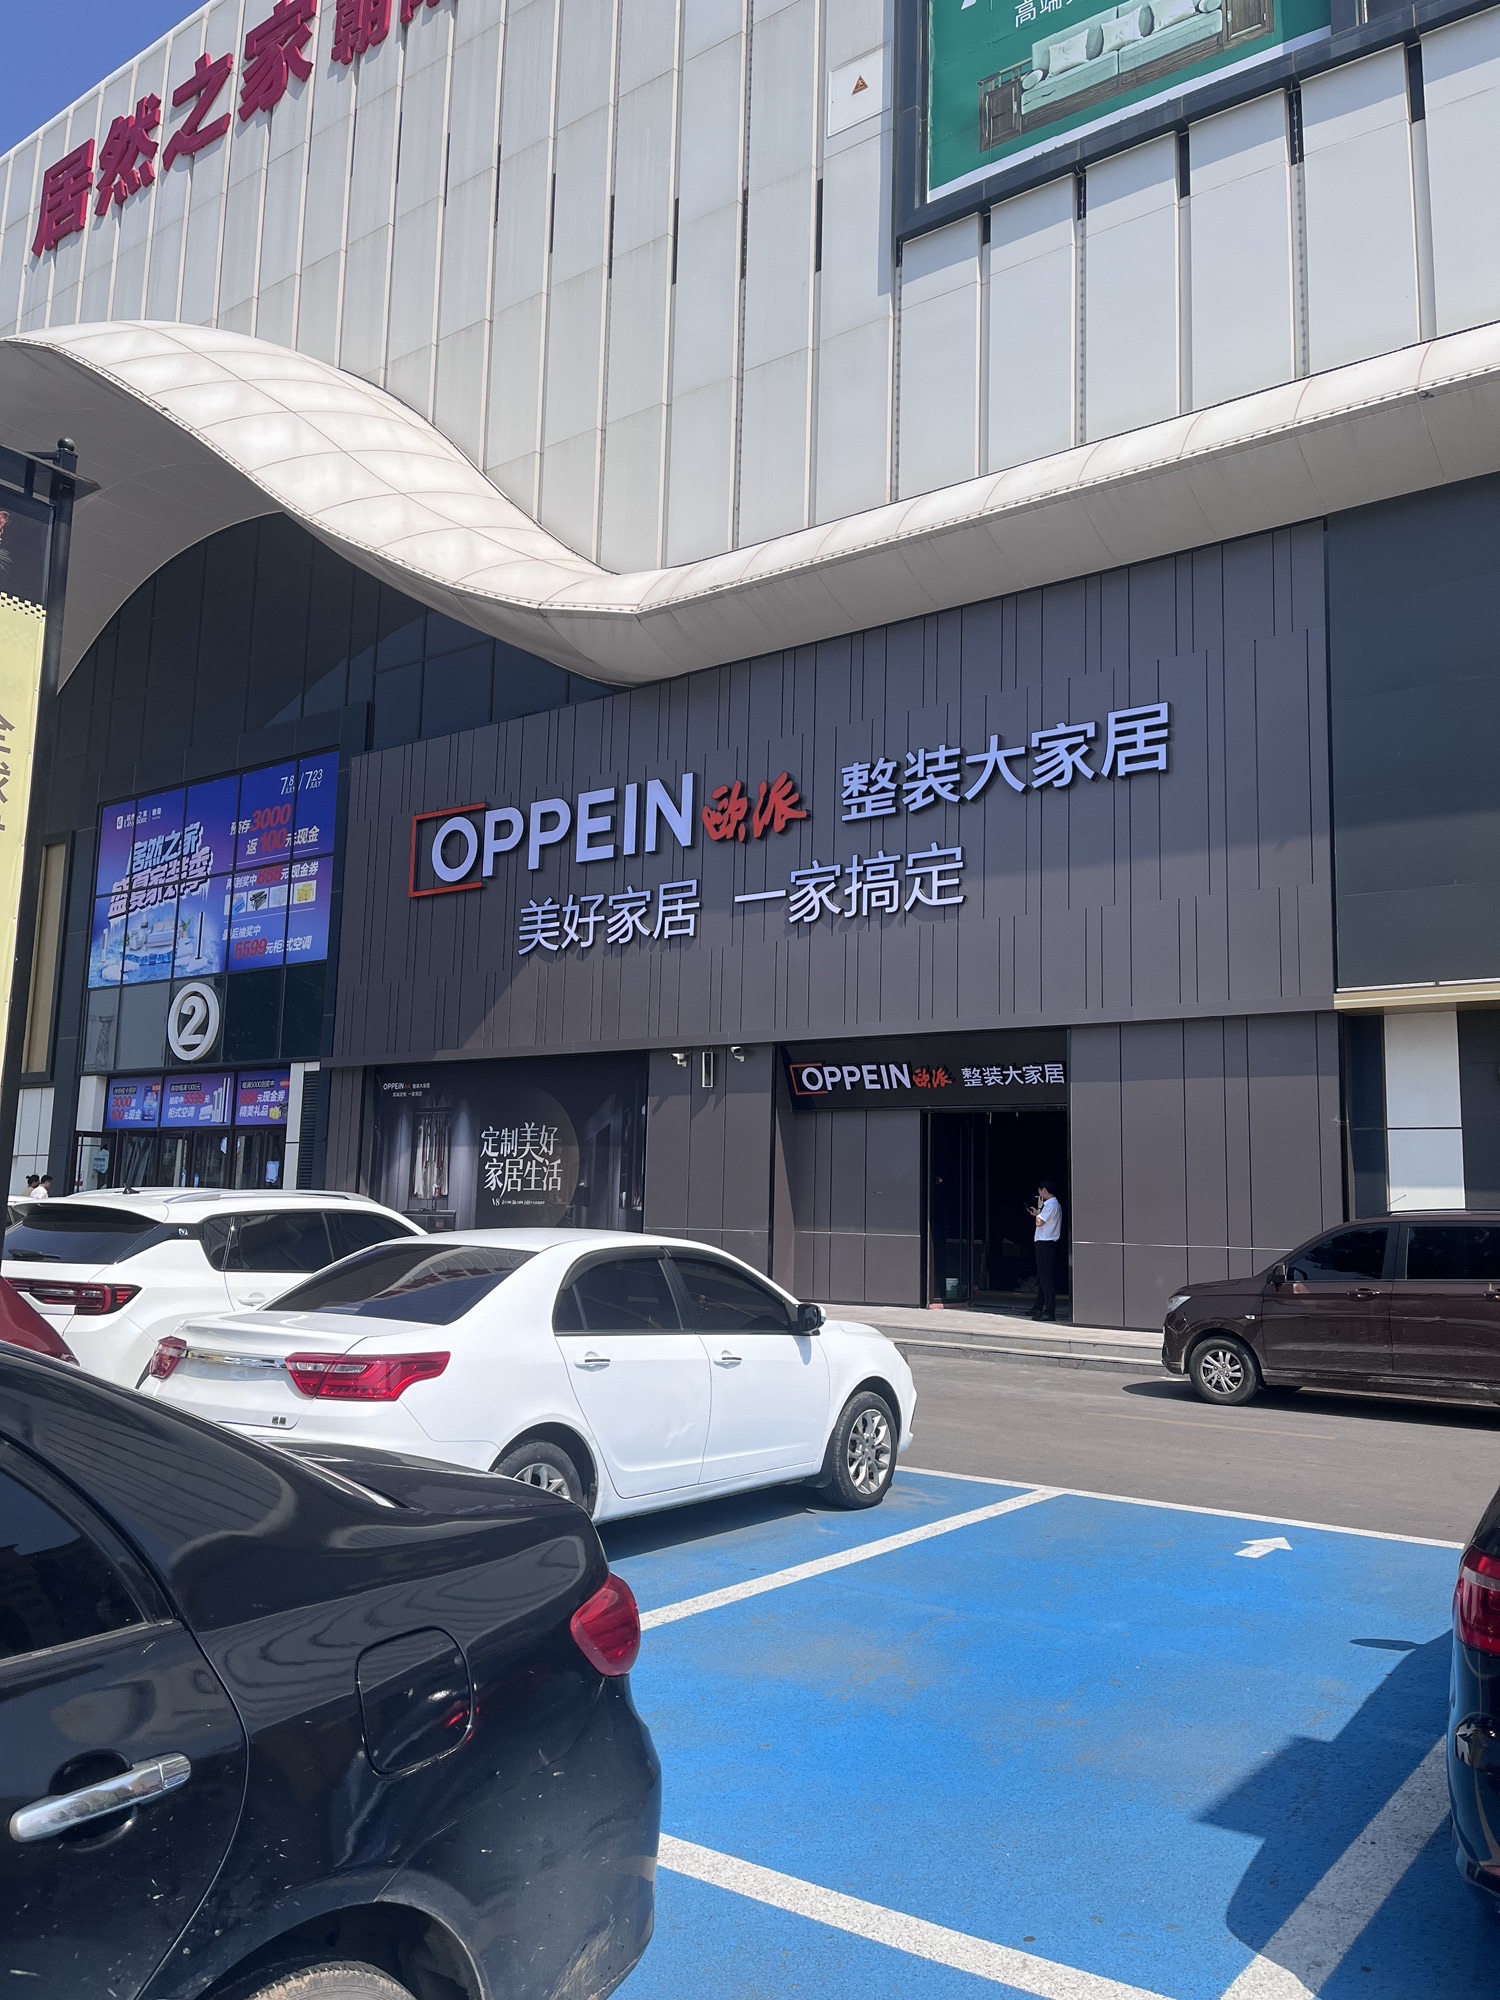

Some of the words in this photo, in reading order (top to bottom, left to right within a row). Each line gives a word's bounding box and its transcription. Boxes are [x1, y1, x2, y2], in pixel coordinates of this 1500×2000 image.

[1014, 0, 1073, 28] 高端
[31, 0, 442, 258] 居然之家朝
[841, 701, 1171, 823] 整装大家居
[431, 772, 695, 883] OPPEIN
[517, 878, 701, 956] 美好家居
[733, 841, 967, 924] 一家搞定
[383, 1082, 405, 1090] OPPEIN
[801, 1062, 912, 1091] OPPEIN
[960, 1062, 1066, 1088] 整装大家居
[238, 1104, 269, 1118] 精美礼品
[479, 1121, 560, 1165] 定制美好
[483, 1157, 564, 1199] 家居生活
